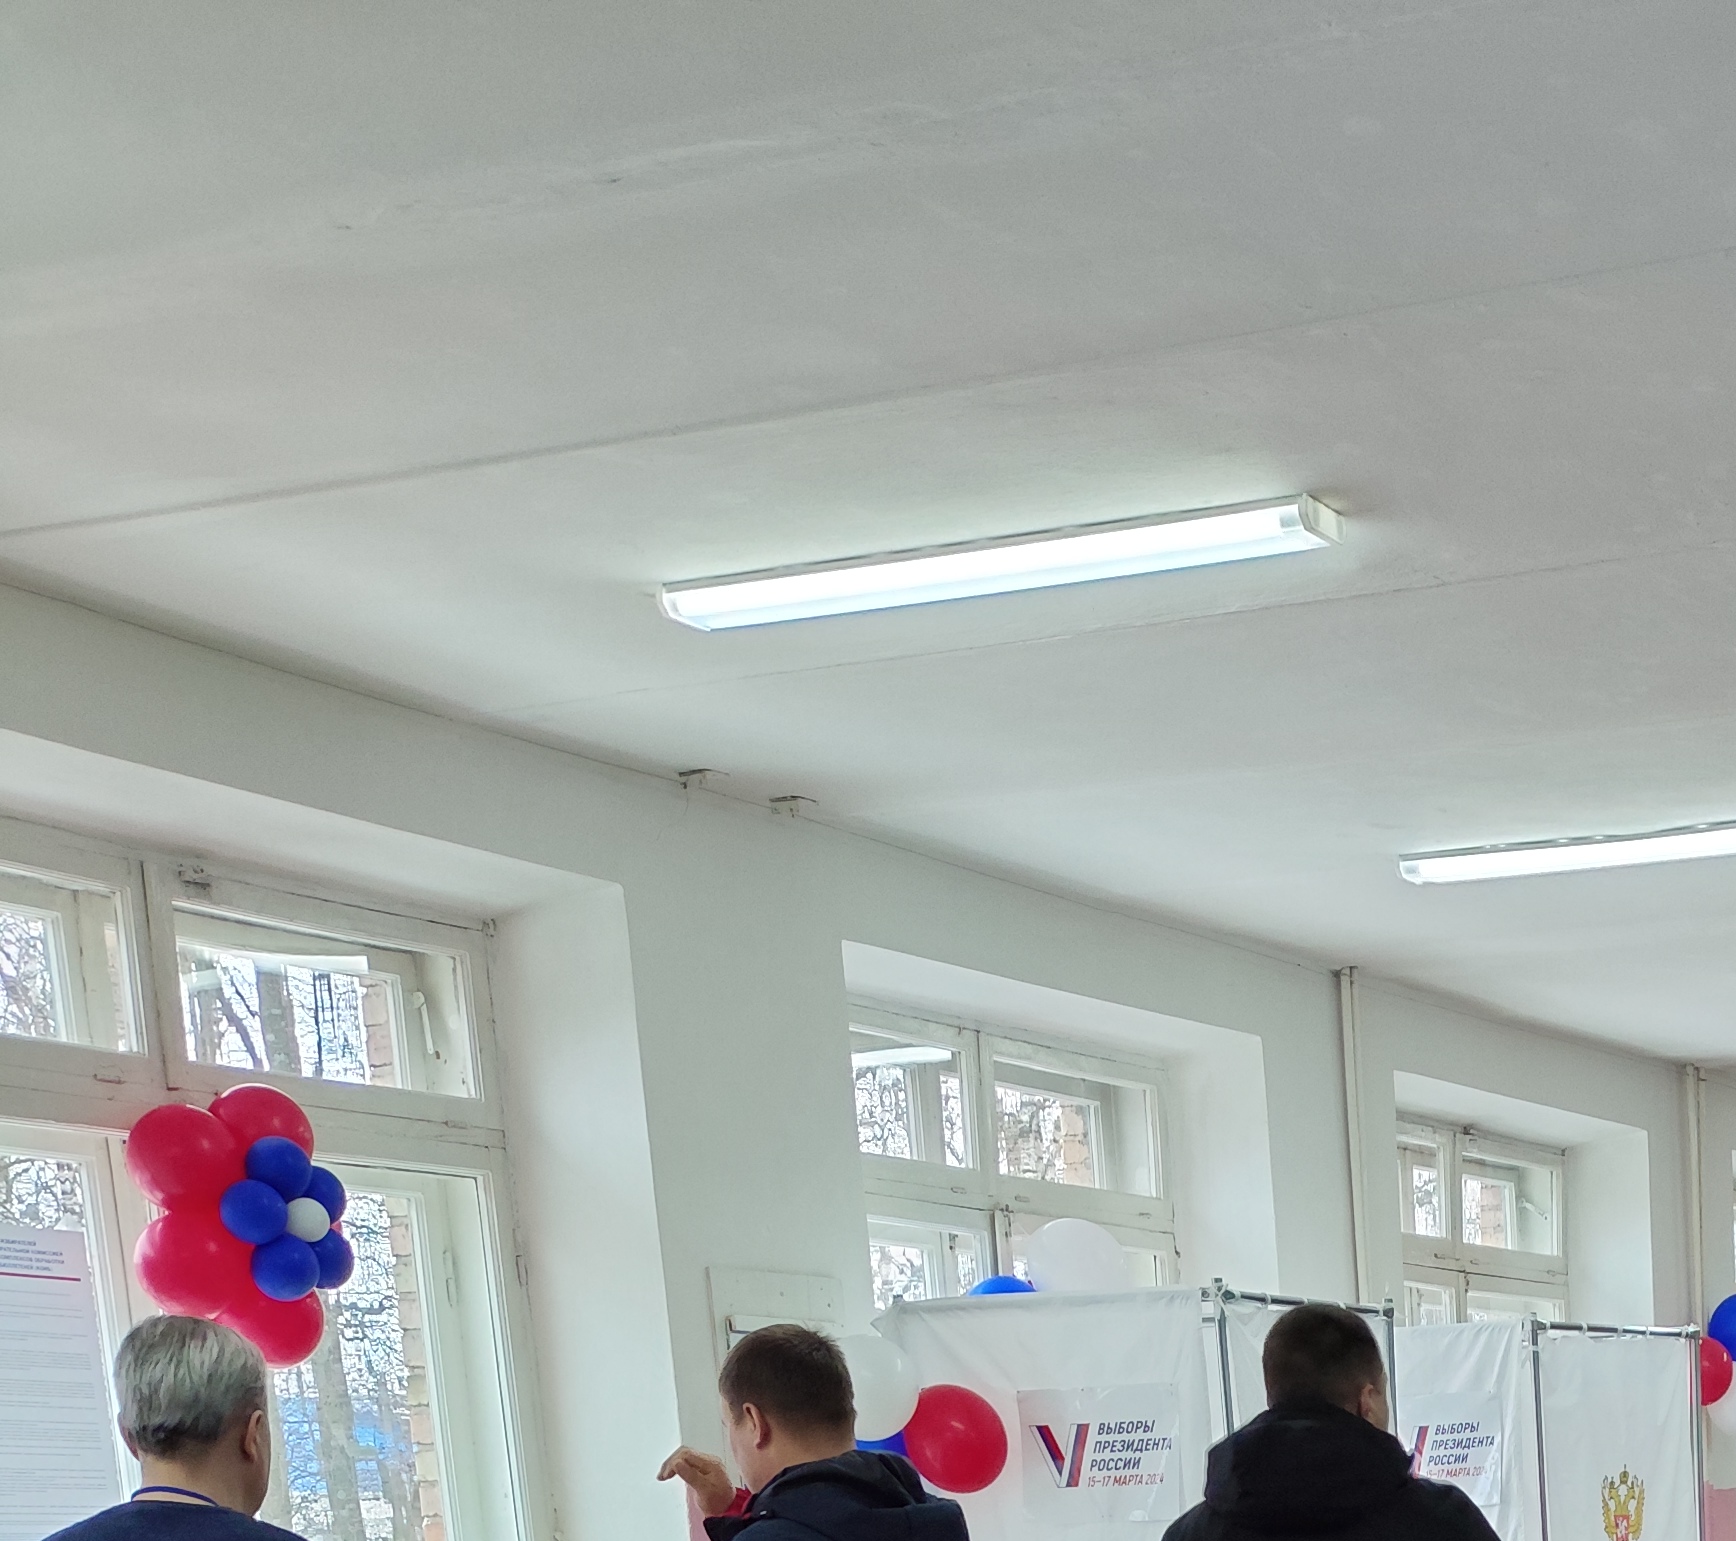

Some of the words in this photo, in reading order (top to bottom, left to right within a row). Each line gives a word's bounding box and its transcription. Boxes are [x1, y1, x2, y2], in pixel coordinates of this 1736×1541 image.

[1097, 1420, 1156, 1436] ВЫБОРЫ
[1434, 1421, 1480, 1436] ВЫБОРЫ
[1093, 1437, 1173, 1454] ПРЕЗИДЕНТА
[1430, 1436, 1495, 1451] ПРЕЗИДЕНТА
[1089, 1456, 1142, 1472] РОССИИ
[1427, 1453, 1469, 1466] РОССИИ
[1445, 1467, 1471, 1478] МАРТА
[1112, 1474, 1144, 1487] МАРТА
